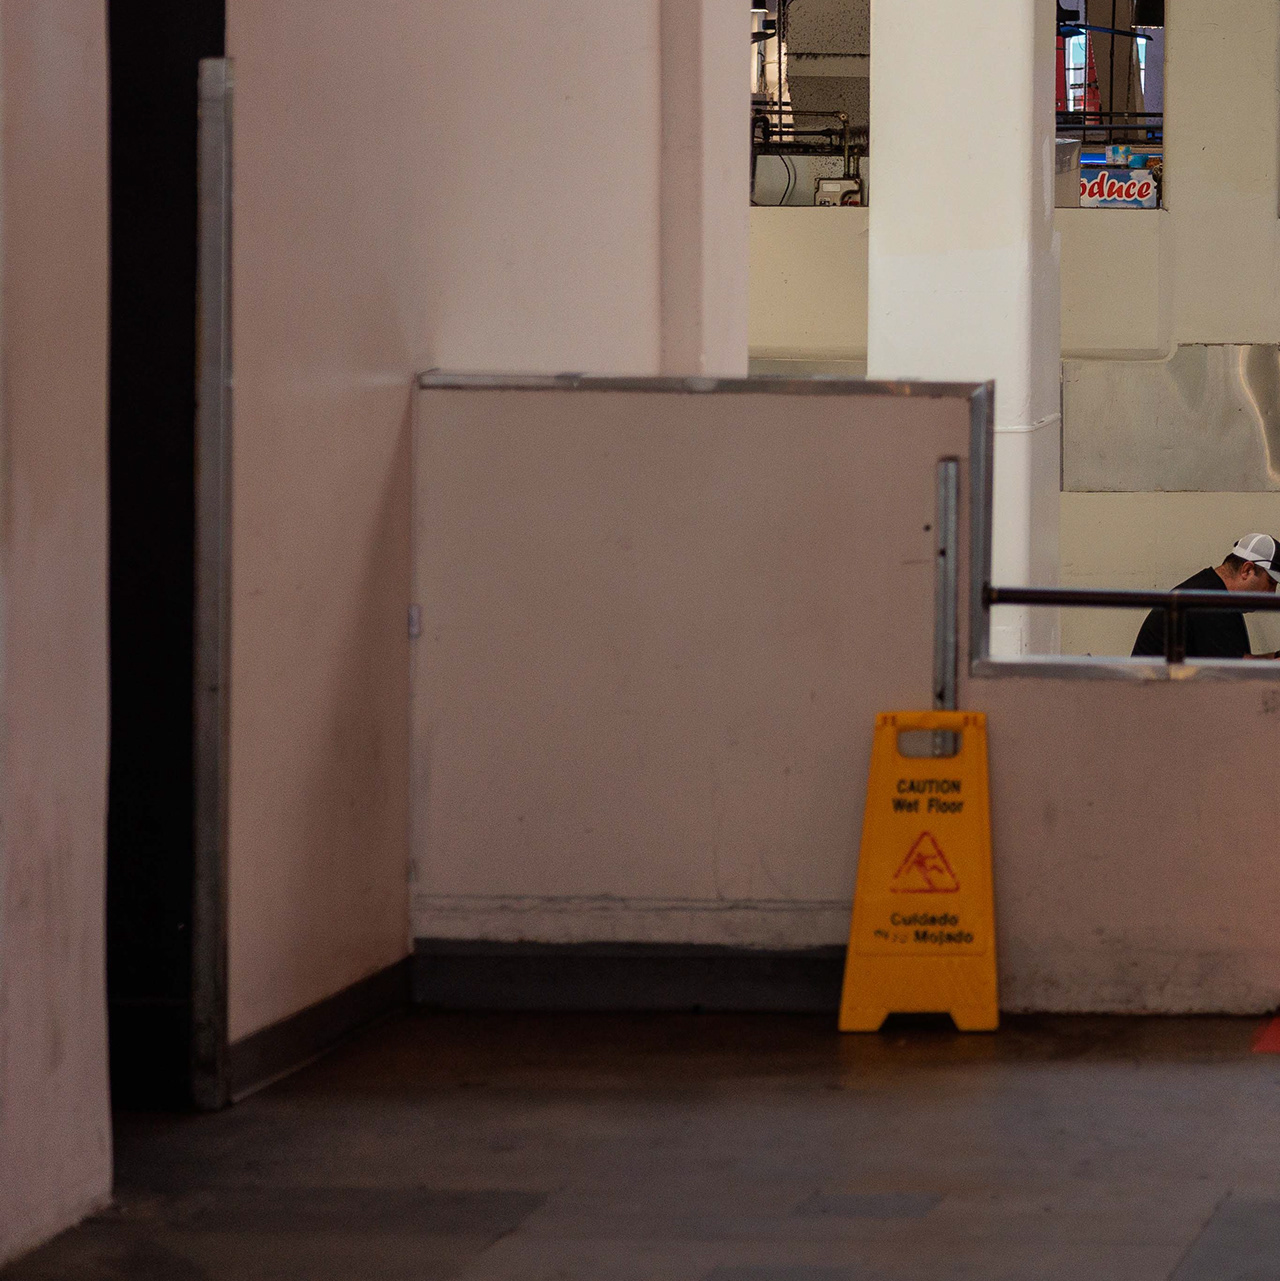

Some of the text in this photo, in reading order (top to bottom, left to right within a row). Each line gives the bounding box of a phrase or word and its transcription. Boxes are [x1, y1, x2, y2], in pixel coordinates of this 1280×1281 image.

[897, 779, 961, 794] CAUTION
[892, 798, 964, 813] Wet Floor
[890, 912, 959, 926] Cuidado
[913, 929, 974, 946] Mojado
